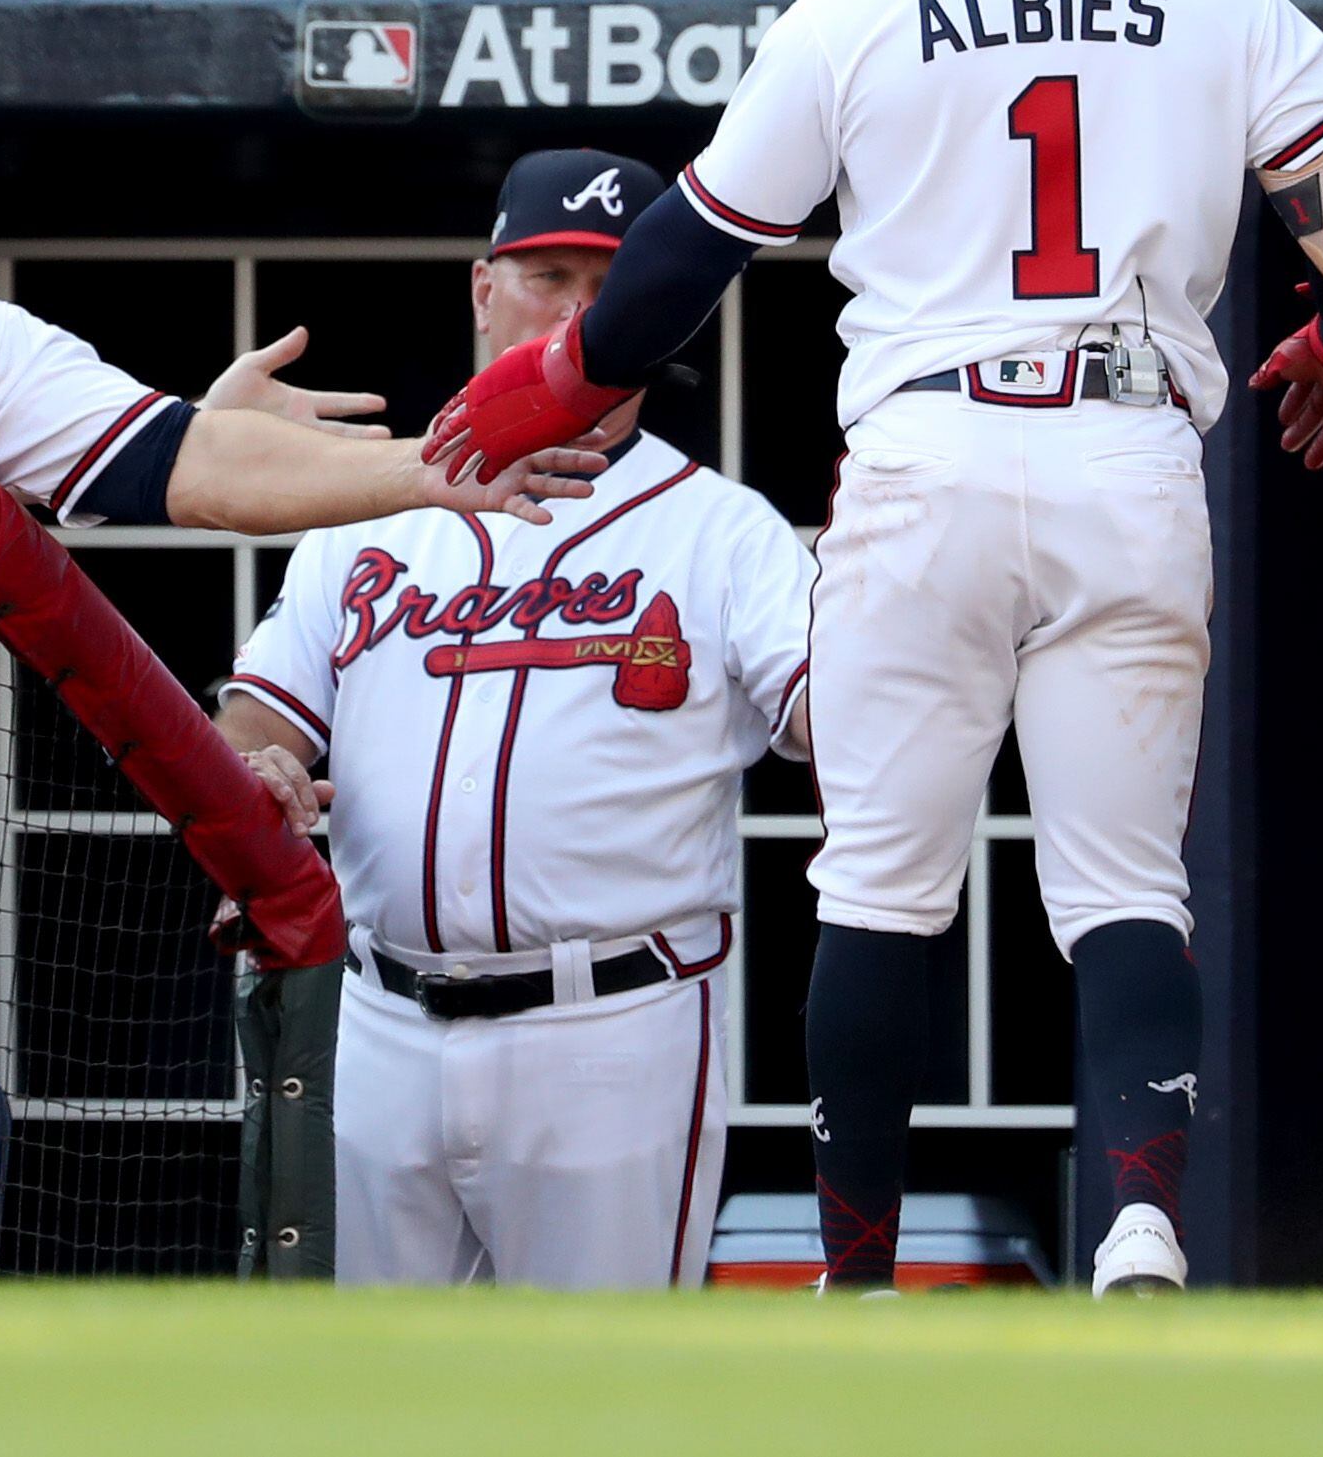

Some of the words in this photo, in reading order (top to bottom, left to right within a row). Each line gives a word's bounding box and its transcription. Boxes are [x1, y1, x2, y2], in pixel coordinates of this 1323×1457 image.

[562, 167, 624, 217] A
[1007, 74, 1101, 301] 1
[330, 547, 644, 670] Braves
